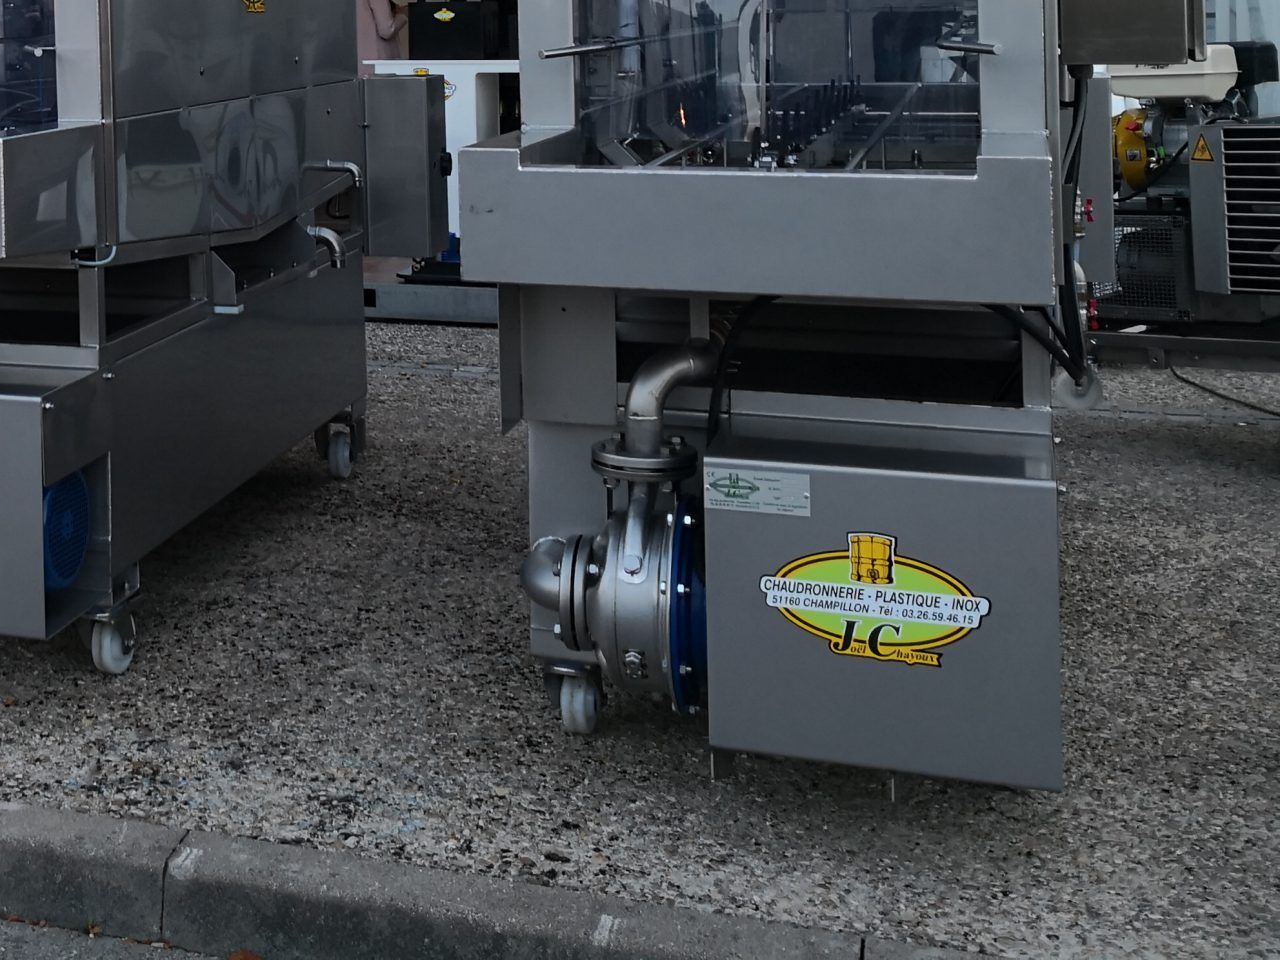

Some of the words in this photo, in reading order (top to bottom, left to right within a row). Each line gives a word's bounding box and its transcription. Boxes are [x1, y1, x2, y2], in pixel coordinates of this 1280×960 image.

[763, 578, 864, 601] CHAUDRONNERIE
[875, 590, 941, 610] PLASTIQUE
[951, 598, 981, 613] INOX
[772, 594, 801, 606] 51160
[803, 597, 869, 614] CHAMPILLON
[878, 605, 893, 617] Tél
[901, 609, 975, 625] 03.26.59.46.15
